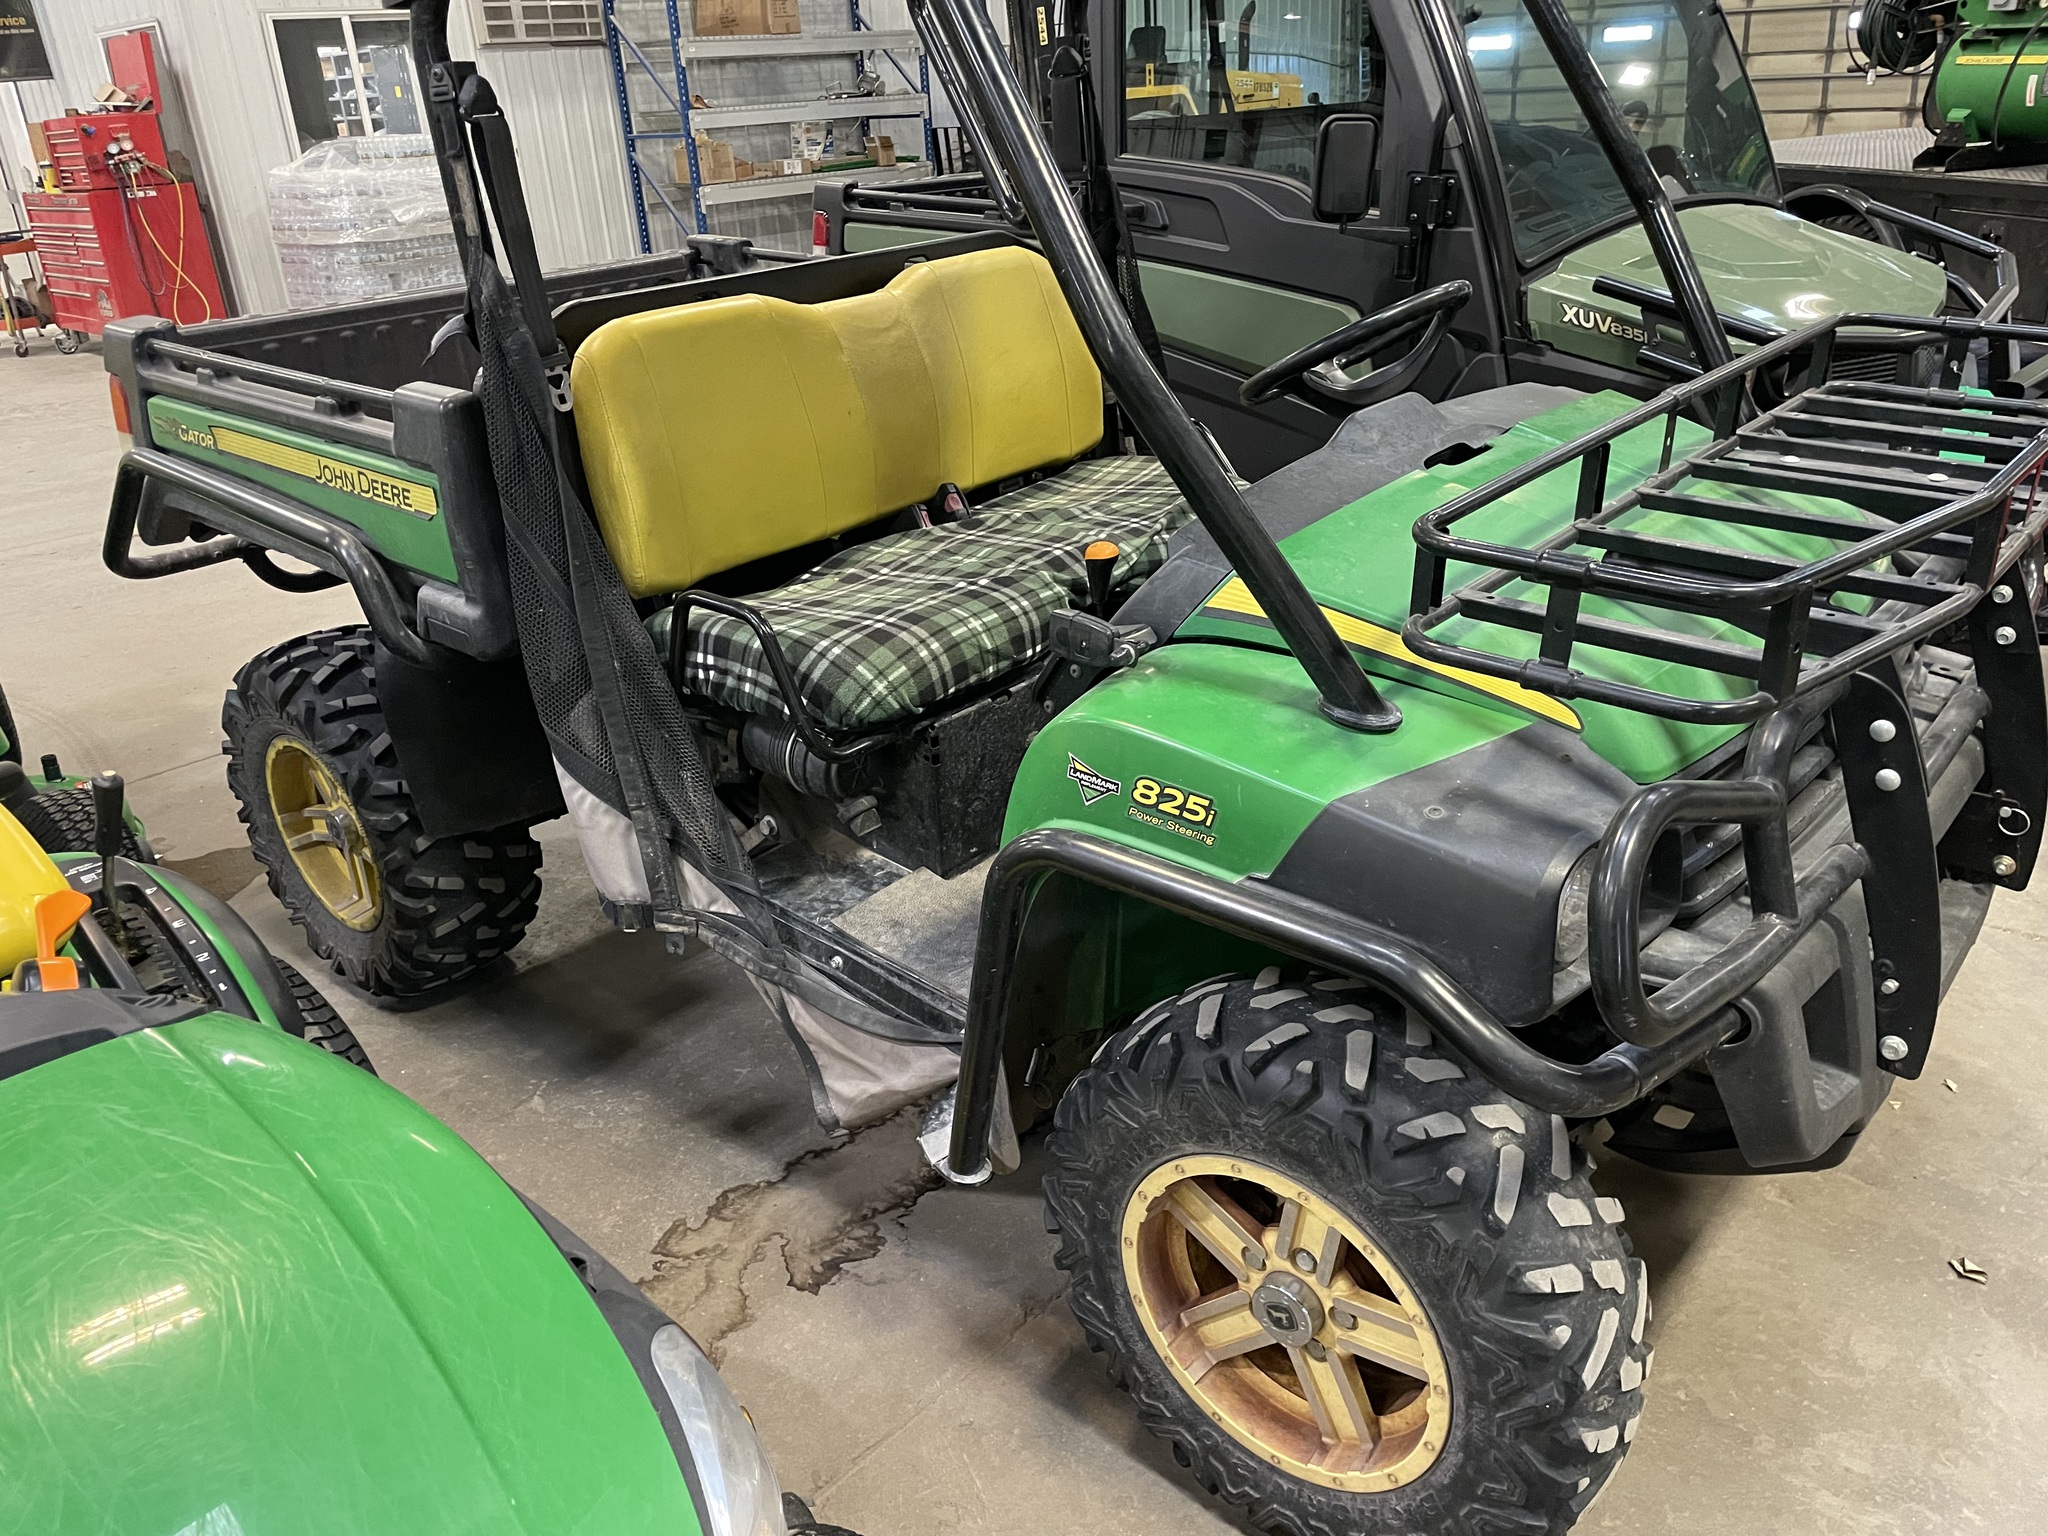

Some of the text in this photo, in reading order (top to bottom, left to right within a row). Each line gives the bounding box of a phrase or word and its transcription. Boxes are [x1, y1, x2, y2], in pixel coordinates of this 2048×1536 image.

[178, 424, 215, 450] GATOR
[315, 458, 413, 508] JOHN DEERE
[1069, 768, 1118, 792] LANDMARK
[1132, 778, 1216, 827] 825i
[1128, 807, 1215, 846] Power Steering
